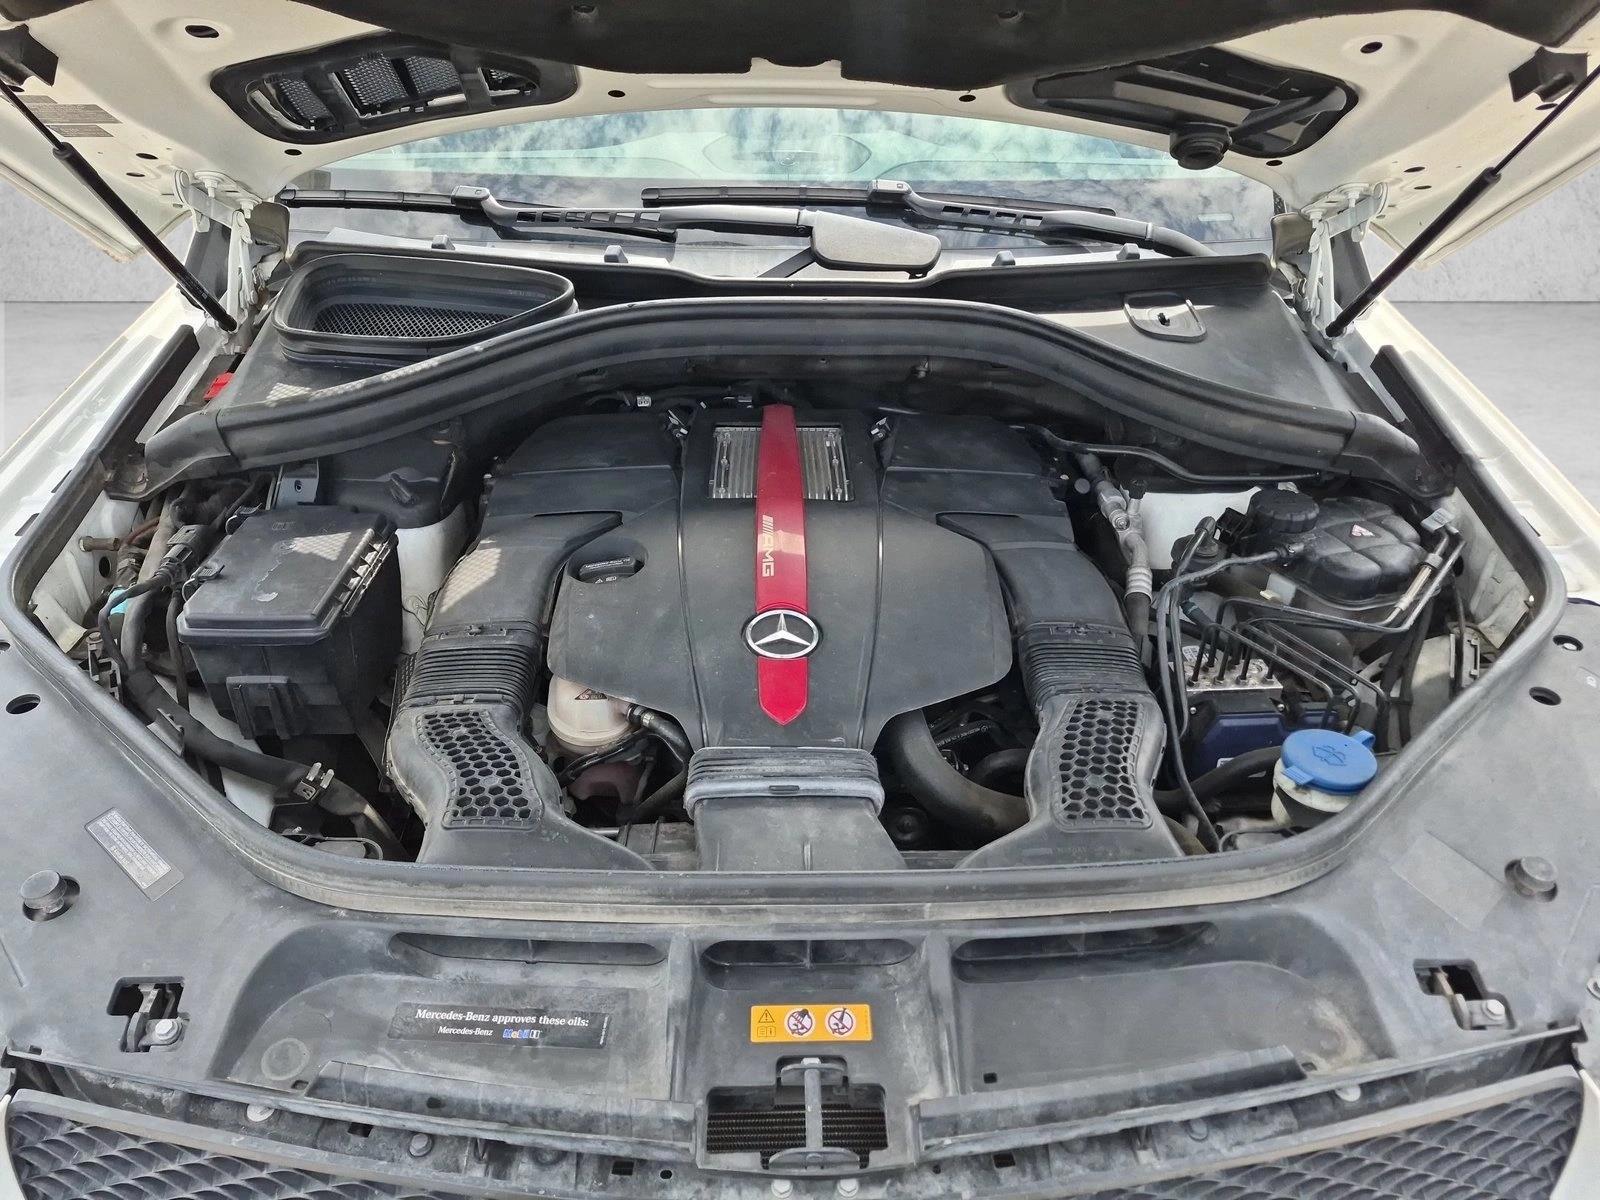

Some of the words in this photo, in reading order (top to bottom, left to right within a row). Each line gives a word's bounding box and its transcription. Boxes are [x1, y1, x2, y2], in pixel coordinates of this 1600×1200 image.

[762, 533, 774, 577] AMG
[415, 1008, 491, 1022] Mercedes-Benz
[491, 1015, 536, 1025] approves
[538, 1015, 565, 1025] these
[567, 1017, 589, 1027] oils:
[438, 1025, 494, 1036] Mercedes-Benz
